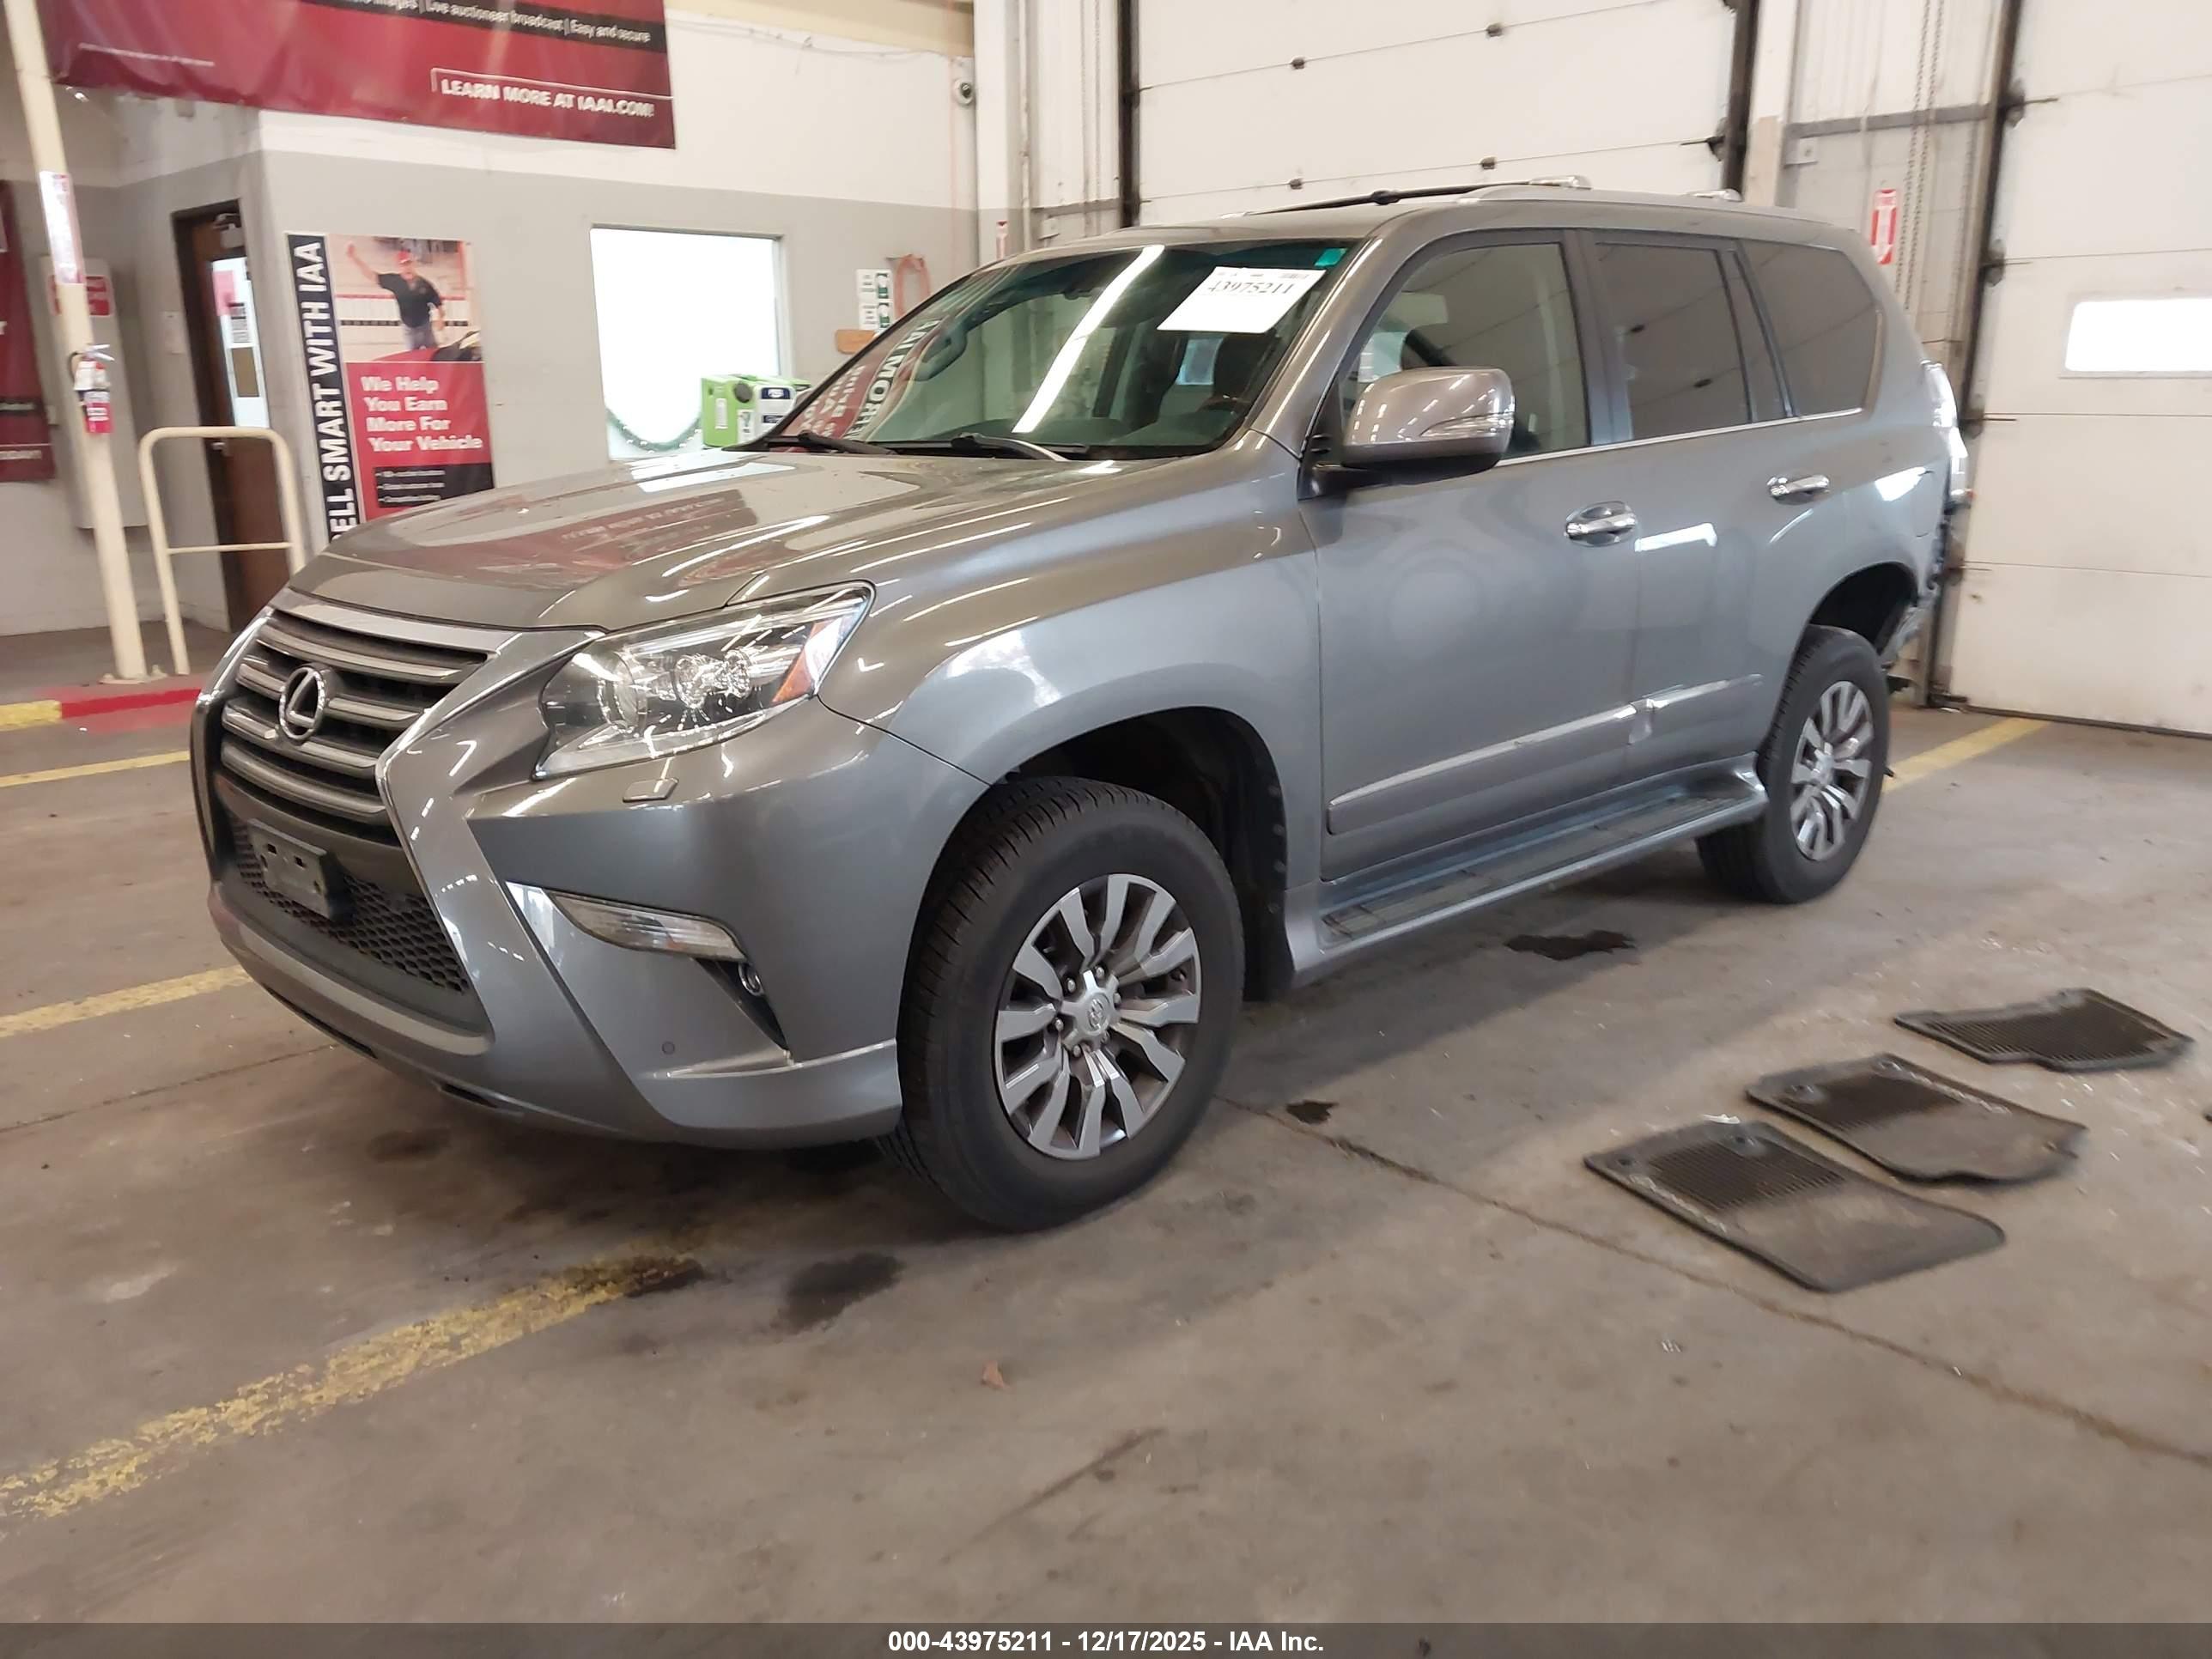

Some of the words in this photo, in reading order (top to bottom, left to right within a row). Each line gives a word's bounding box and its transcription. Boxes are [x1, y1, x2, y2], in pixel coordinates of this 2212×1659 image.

[510, 9, 563, 31] broadcast
[570, 19, 596, 39] Easy
[596, 25, 617, 38] and
[441, 79, 501, 100] LEARN
[503, 86, 550, 106] MORE
[553, 92, 575, 109] AT
[294, 241, 327, 292] IAA
[1206, 280, 1295, 295] 43975211
[301, 301, 338, 377] WITH
[361, 376, 392, 392] We
[395, 376, 439, 395] Help
[363, 396, 401, 411] You
[404, 396, 447, 411] Earn
[312, 383, 351, 482] SMART
[366, 416, 416, 432] More
[419, 416, 451, 430] For
[368, 436, 414, 452] Your
[416, 434, 483, 451] Vehicle
[325, 488, 358, 541] ELL
